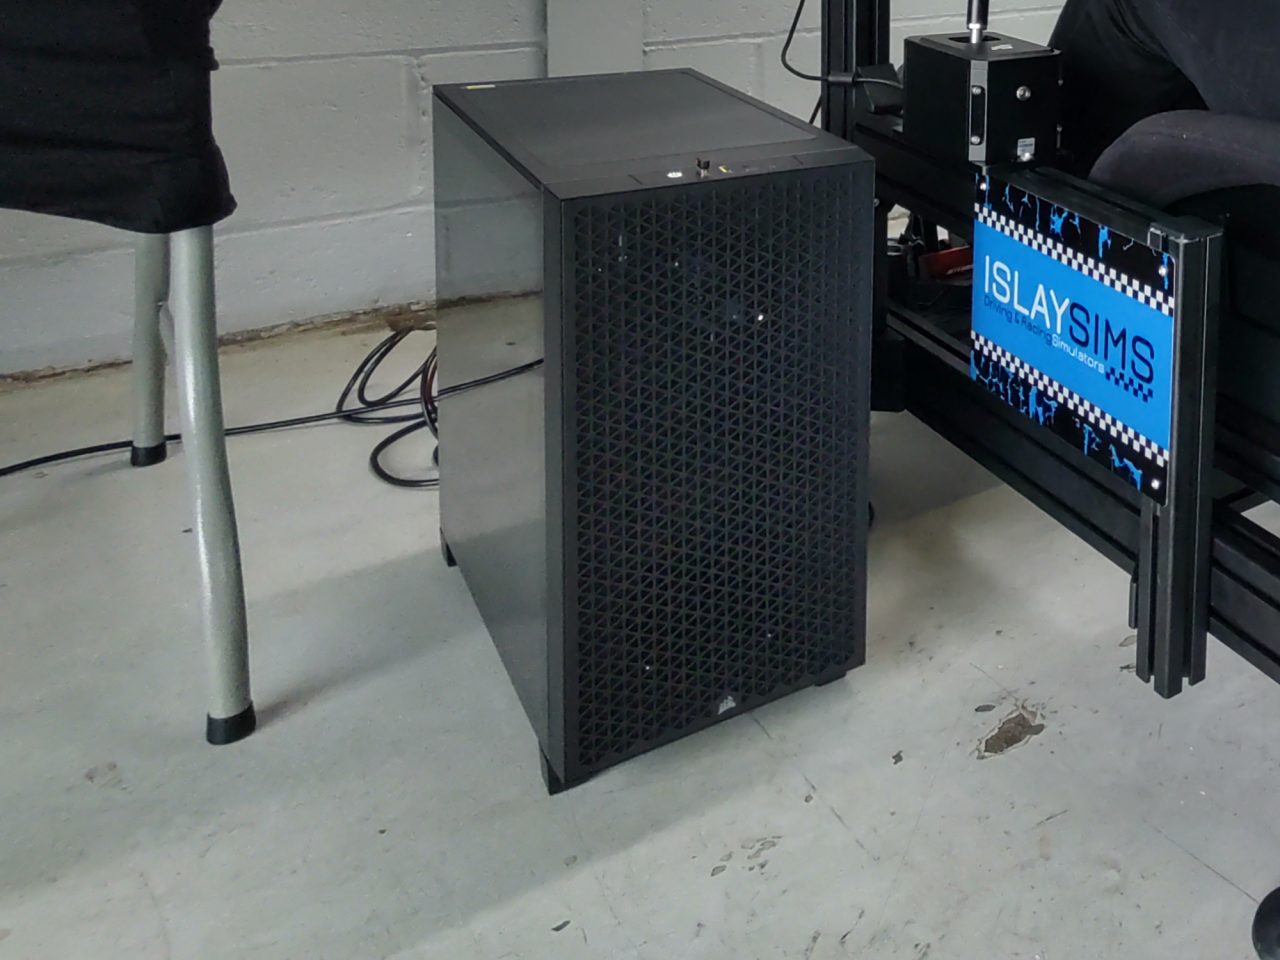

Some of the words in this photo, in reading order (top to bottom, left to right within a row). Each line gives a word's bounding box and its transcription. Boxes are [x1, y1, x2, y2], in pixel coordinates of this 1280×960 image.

[983, 294, 1013, 324] Driving
[1021, 316, 1054, 347] Racing
[1051, 332, 1105, 375] Simulators
[984, 254, 1156, 385] ISLAYSIMS
